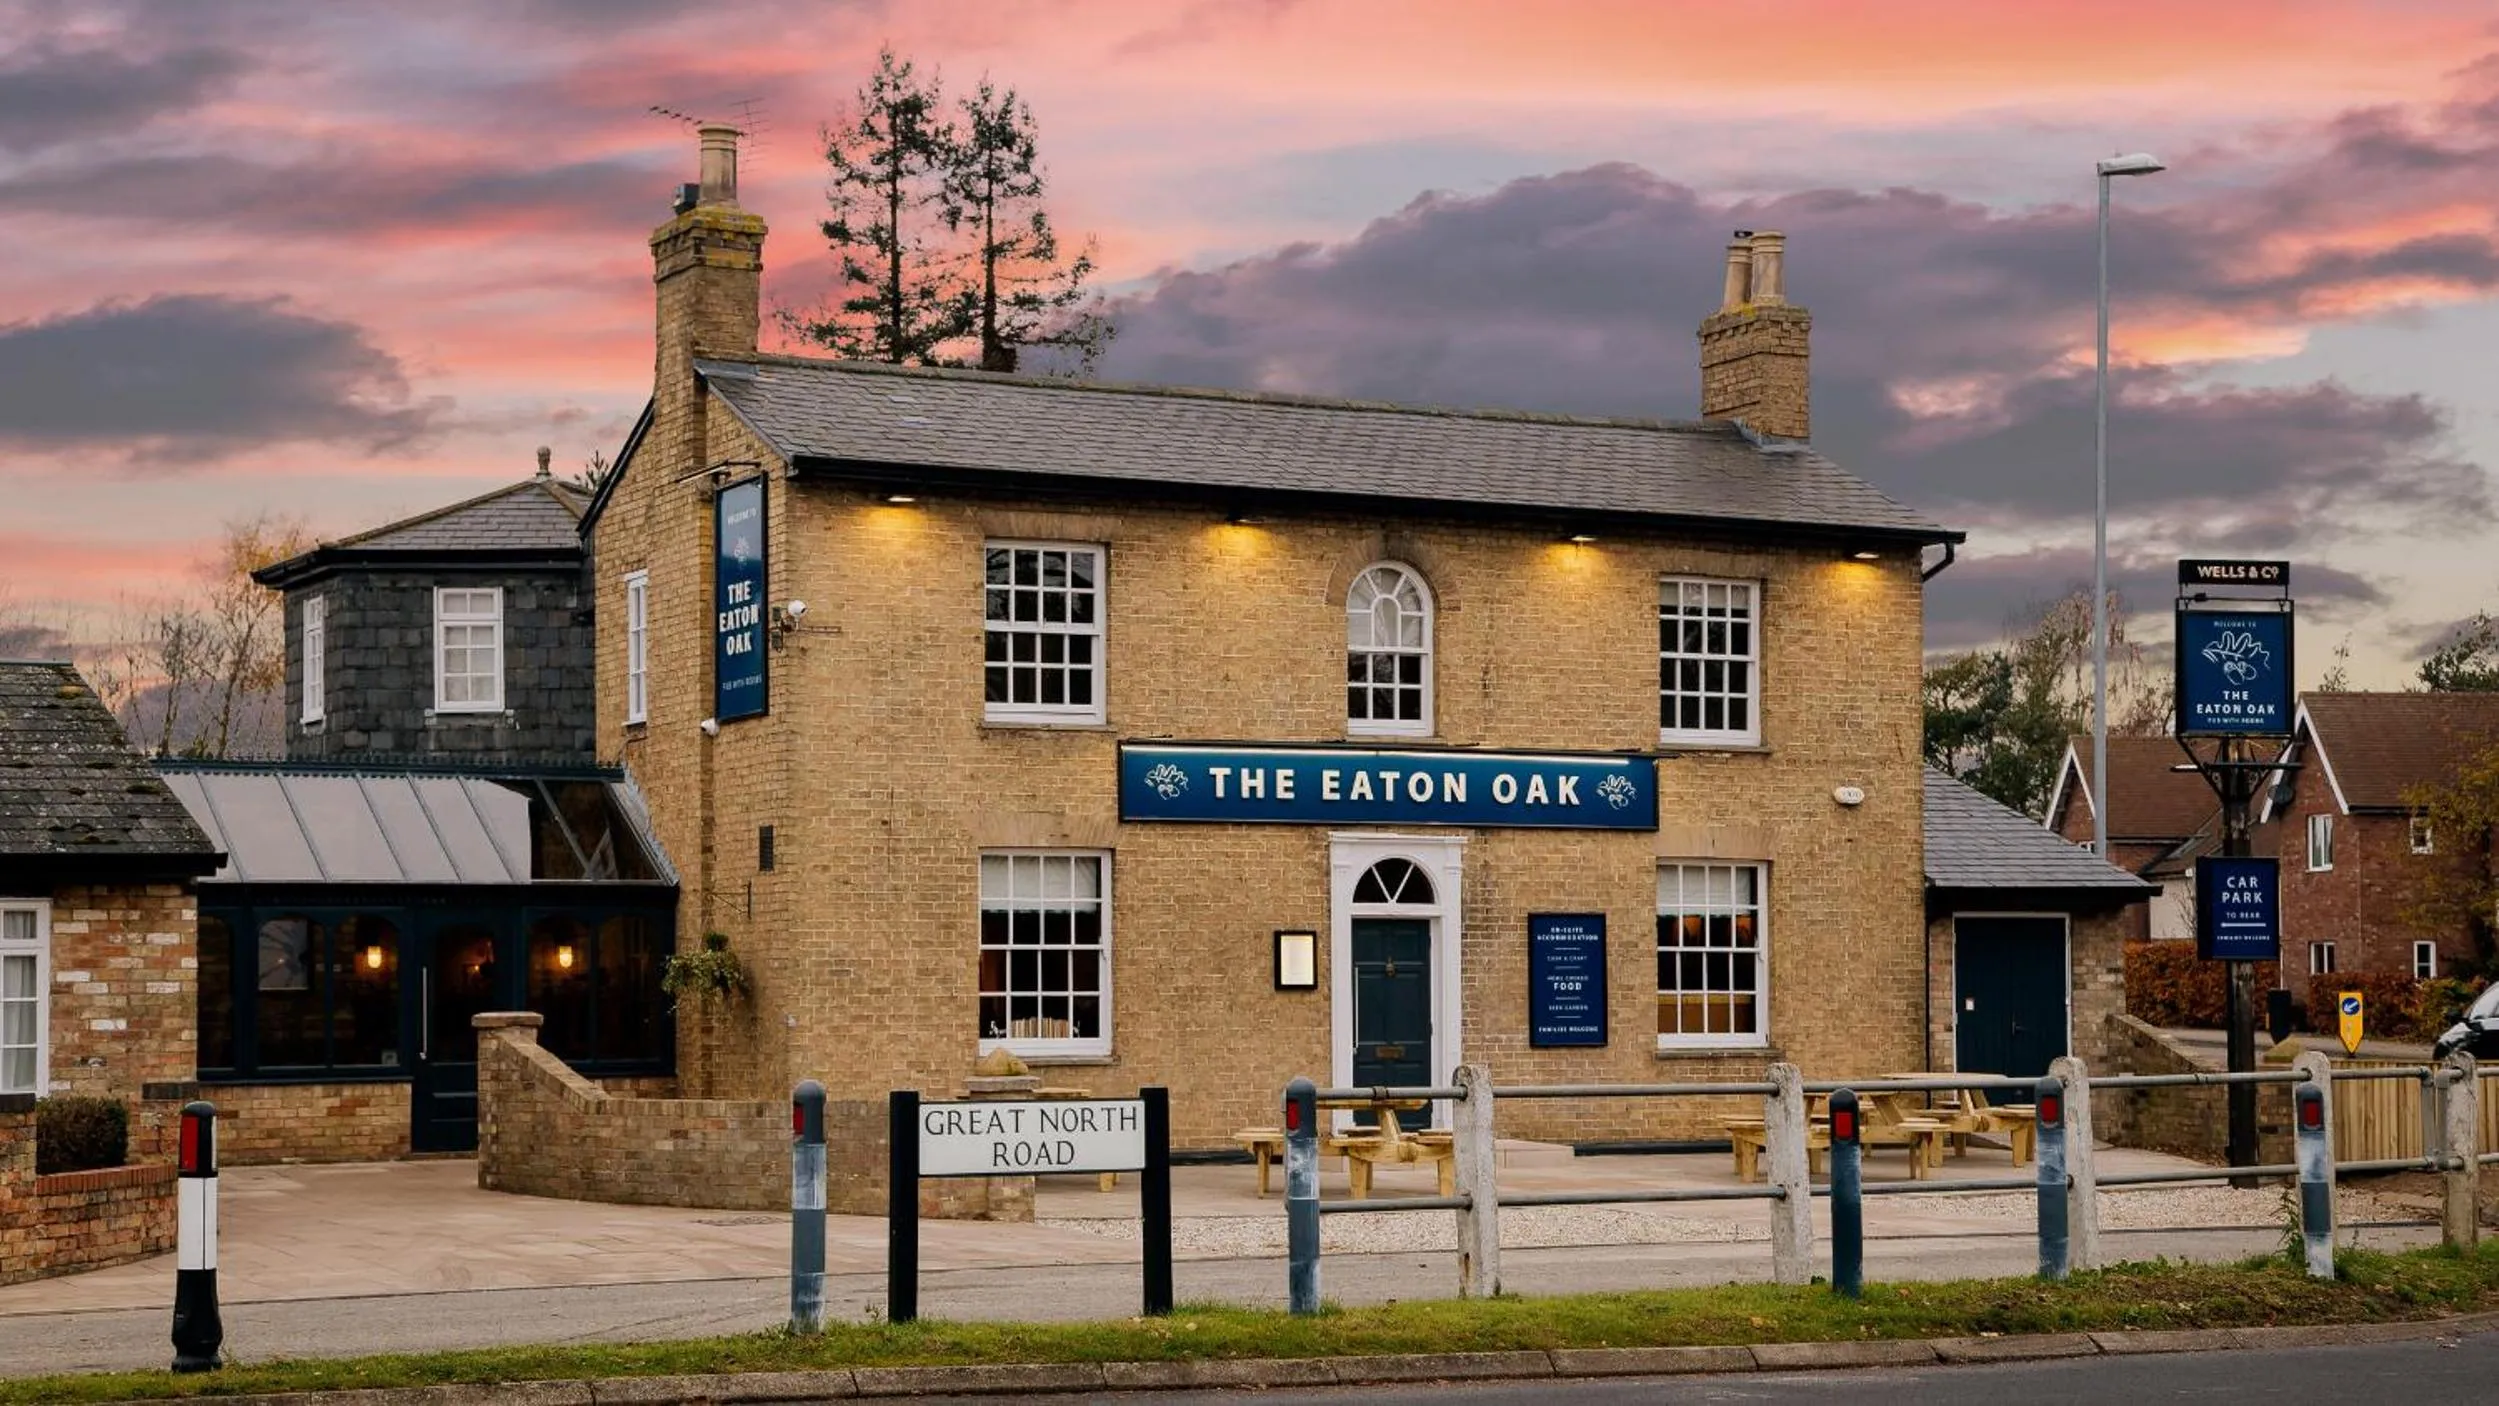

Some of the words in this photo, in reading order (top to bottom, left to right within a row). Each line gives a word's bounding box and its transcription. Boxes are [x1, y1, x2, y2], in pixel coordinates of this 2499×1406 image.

[2197, 565, 2245, 579] WELLS
[2248, 566, 2258, 579] &
[728, 580, 752, 604] THE
[719, 603, 759, 632] EATON
[725, 631, 752, 656] OAK
[2222, 690, 2249, 701] THE
[2196, 703, 2242, 715] EATON
[2246, 704, 2275, 715] OAK
[1209, 767, 1295, 799] THE
[1322, 769, 1467, 802] EATON
[1492, 773, 1580, 805] OAK
[2226, 875, 2259, 889] CAR
[2222, 891, 2263, 904] PARK
[1553, 982, 1582, 991] FOOD
[925, 1109, 1025, 1136] GREAT
[1040, 1106, 1137, 1133] NORTH
[993, 1140, 1075, 1167] ROAD
